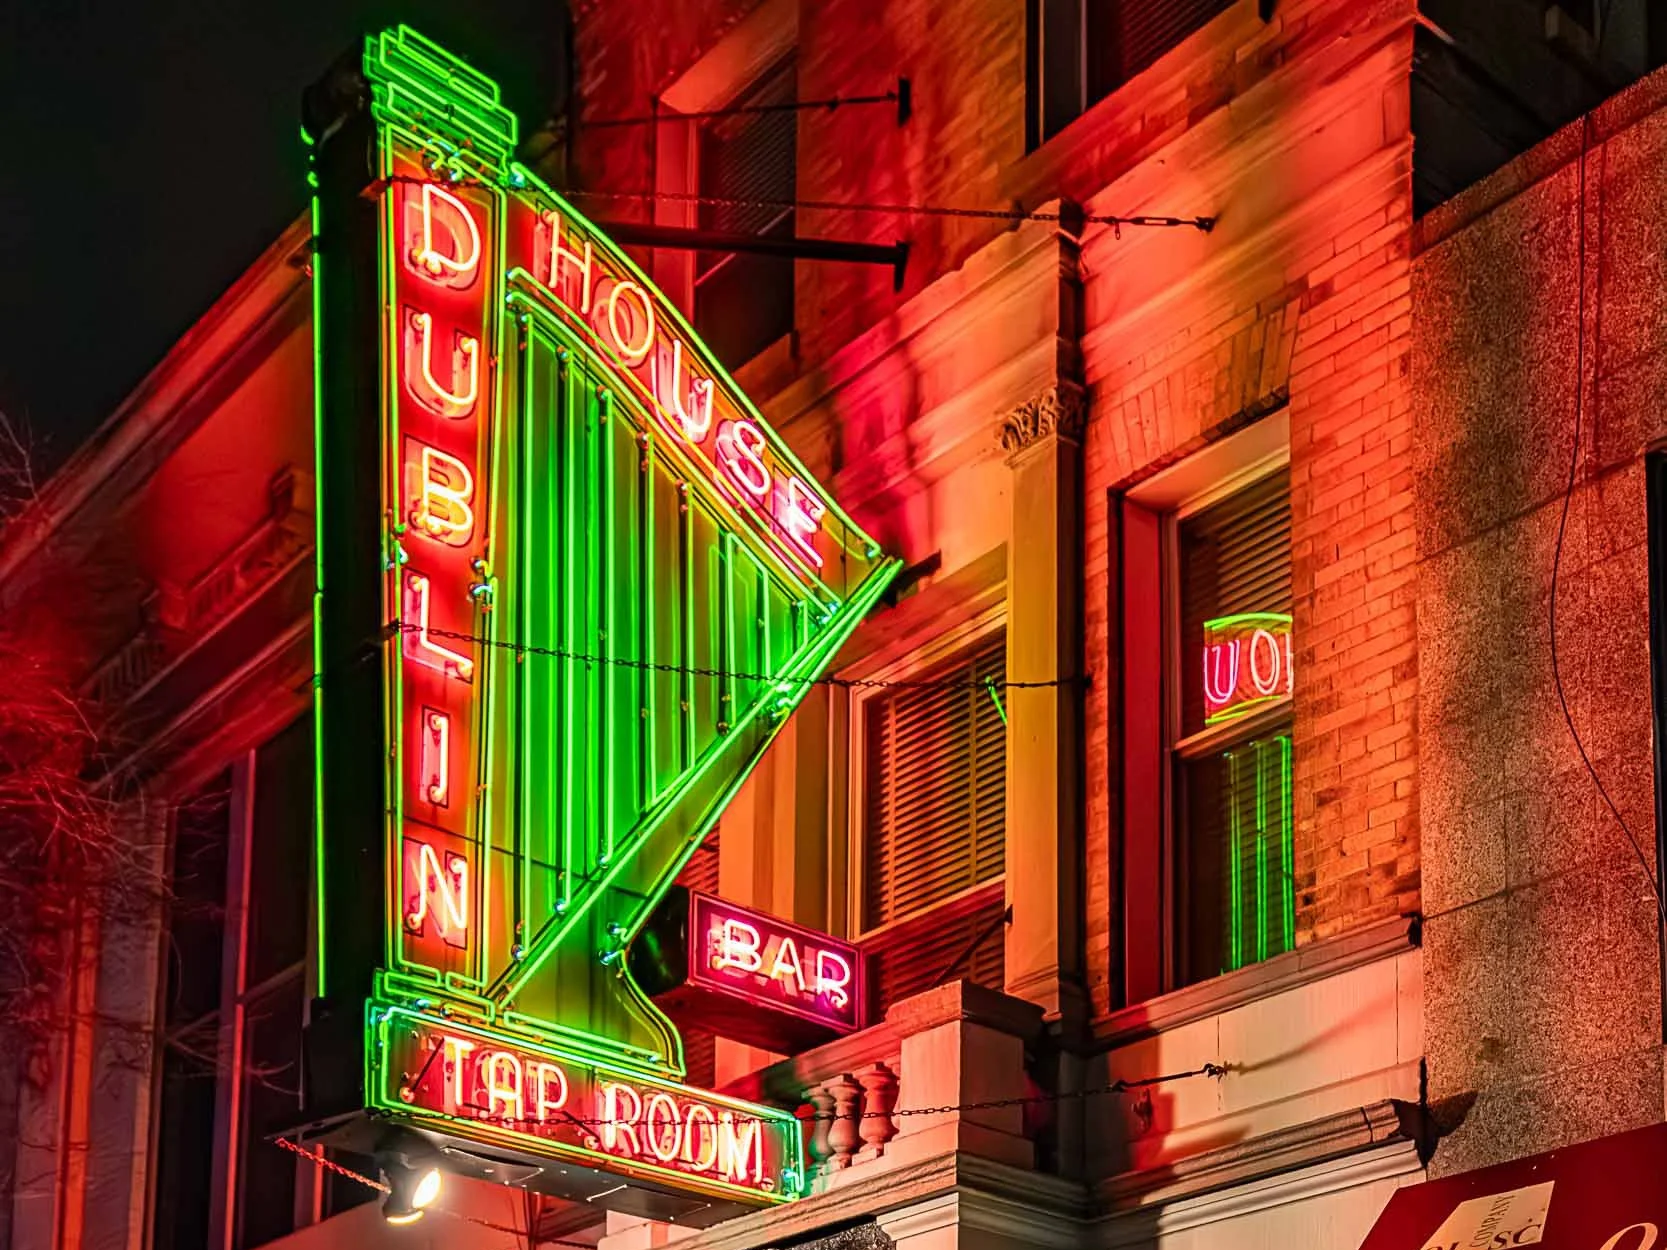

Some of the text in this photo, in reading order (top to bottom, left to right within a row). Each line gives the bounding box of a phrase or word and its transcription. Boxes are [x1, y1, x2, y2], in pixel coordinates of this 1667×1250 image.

[533, 207, 826, 568] HOUSE
[403, 182, 482, 950] DUBLIN
[716, 918, 852, 1009] BAR
[442, 1035, 764, 1184] TAP ROOM
[1469, 1194, 1517, 1249] COMPANY
